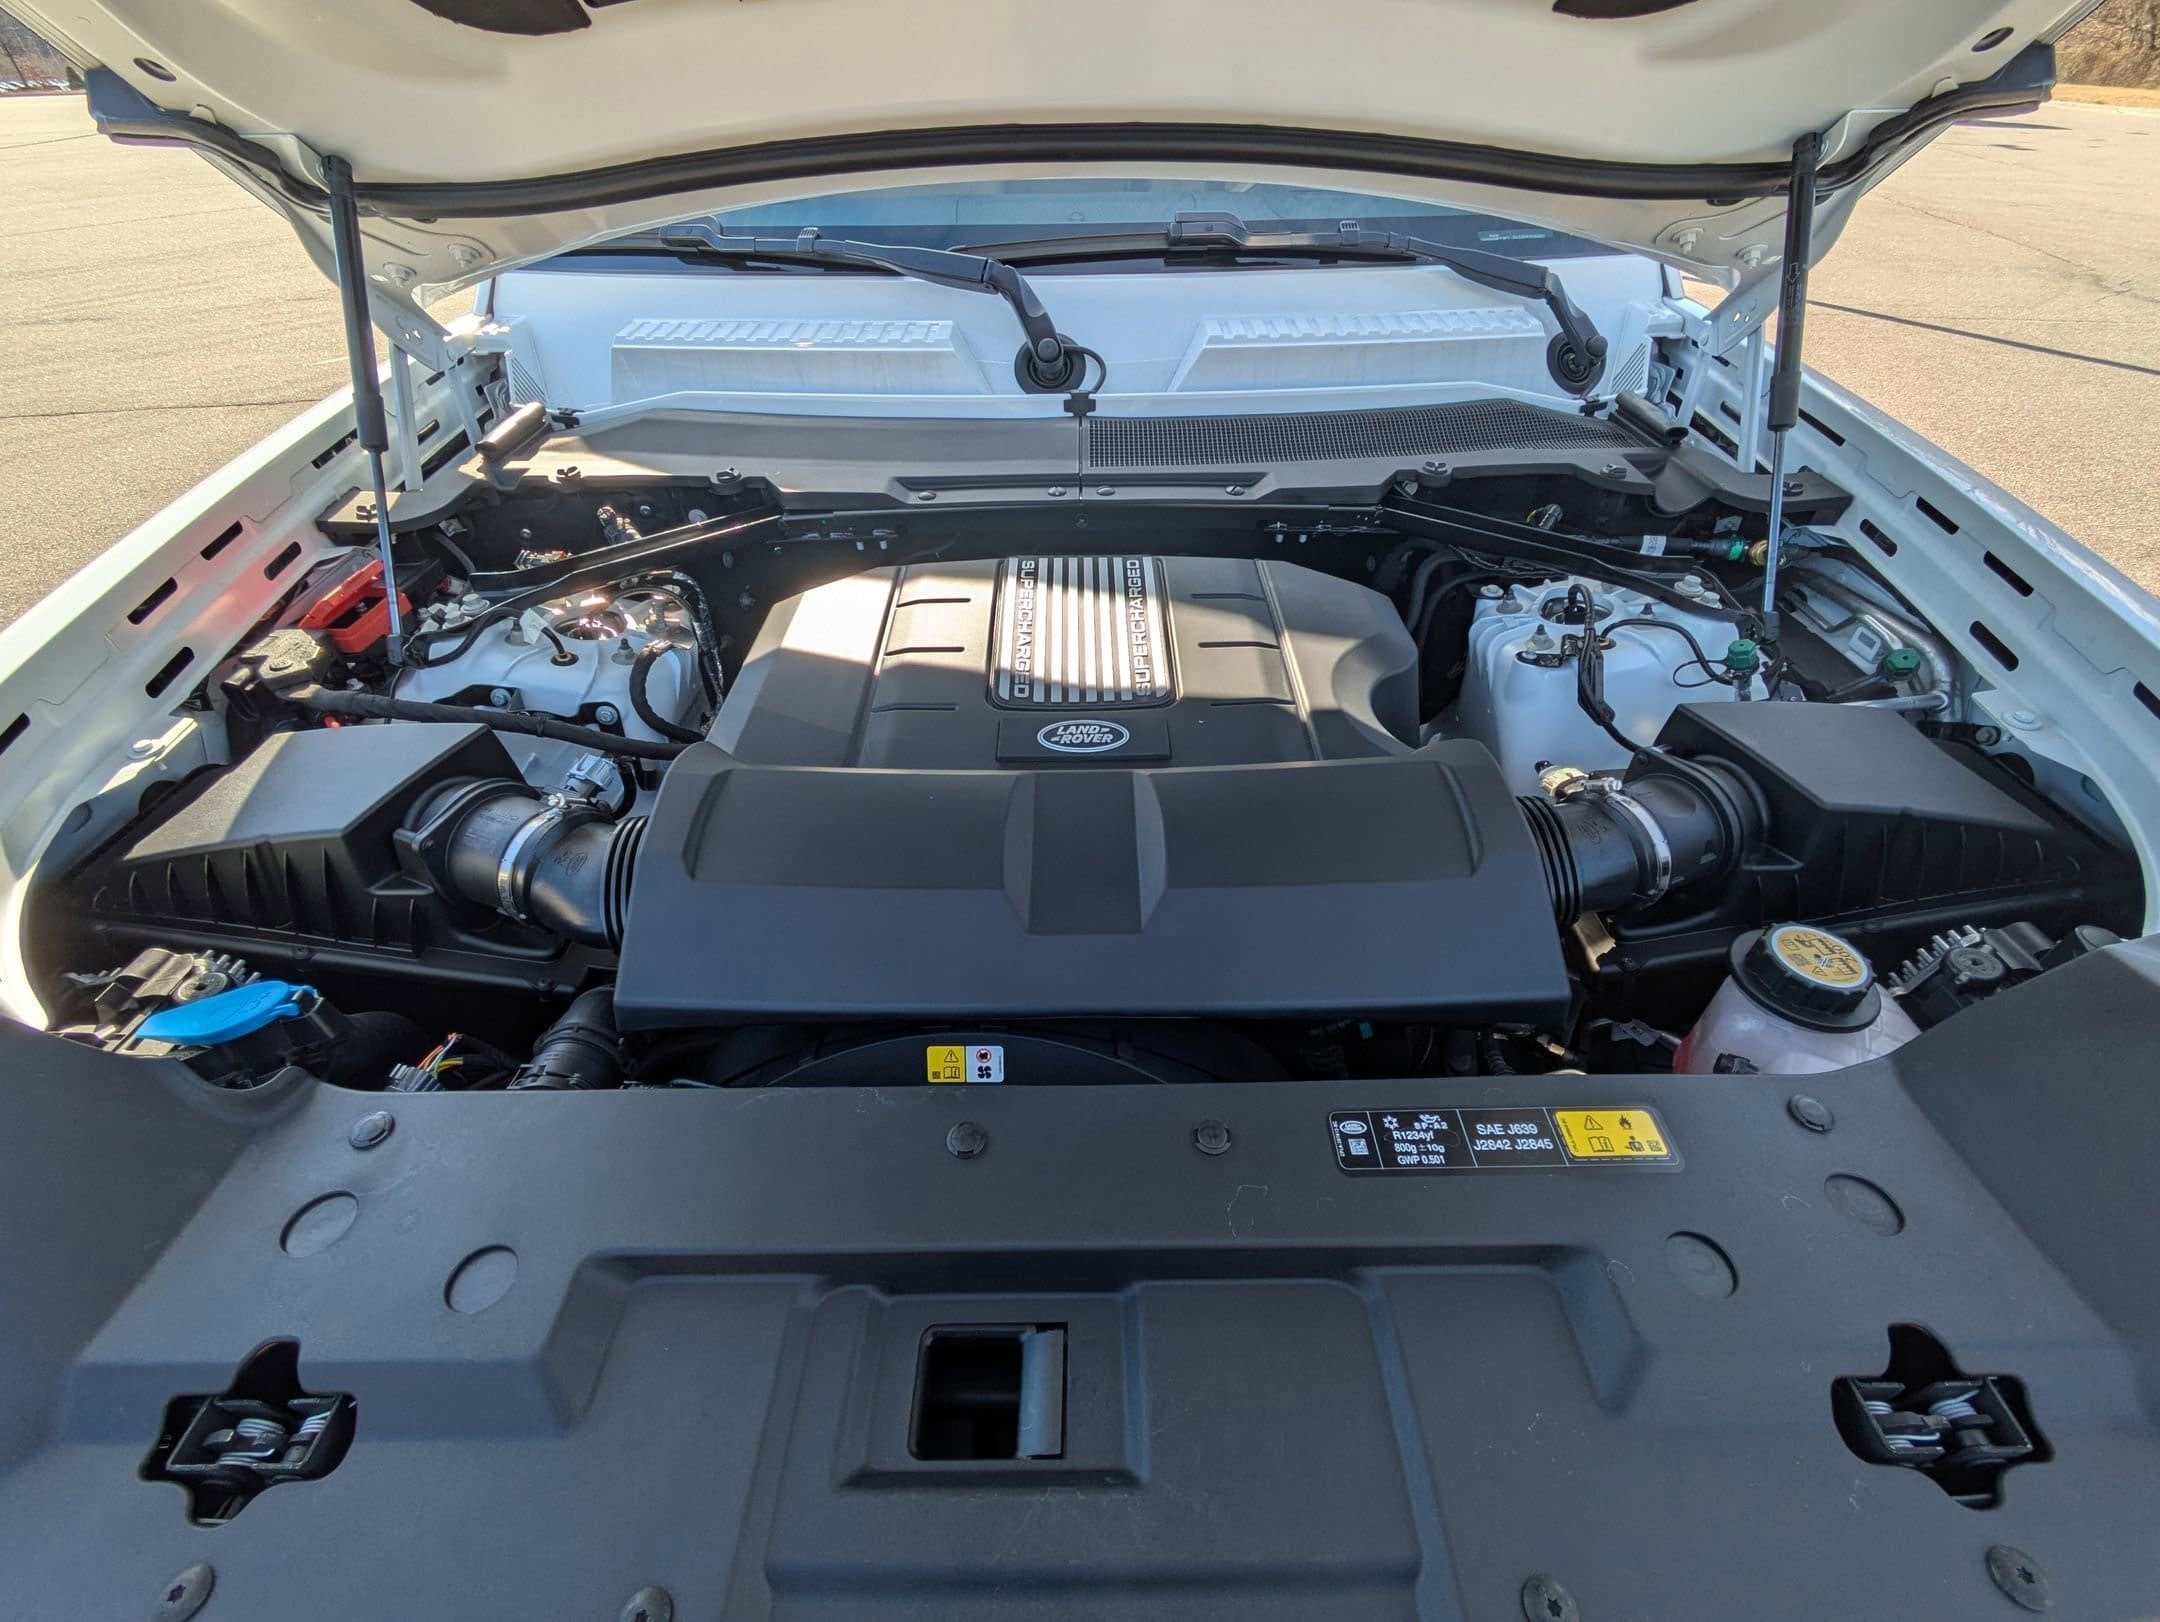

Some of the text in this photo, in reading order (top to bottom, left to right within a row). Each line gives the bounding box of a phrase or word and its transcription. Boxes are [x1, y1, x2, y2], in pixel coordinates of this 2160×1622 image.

[1013, 560, 1035, 698] SUPERCHARGED
[1127, 559, 1151, 697] SUPERCHARGED
[1056, 725, 1100, 735] LAND
[1059, 733, 1114, 744] ROVER
[1476, 1123, 1538, 1135] SAE J639
[1392, 1130, 1435, 1142] R1234yf
[1394, 1143, 1418, 1154] 800g
[1473, 1138, 1554, 1151] J2842 J2845
[1397, 1154, 1446, 1165] GWP 0.501
